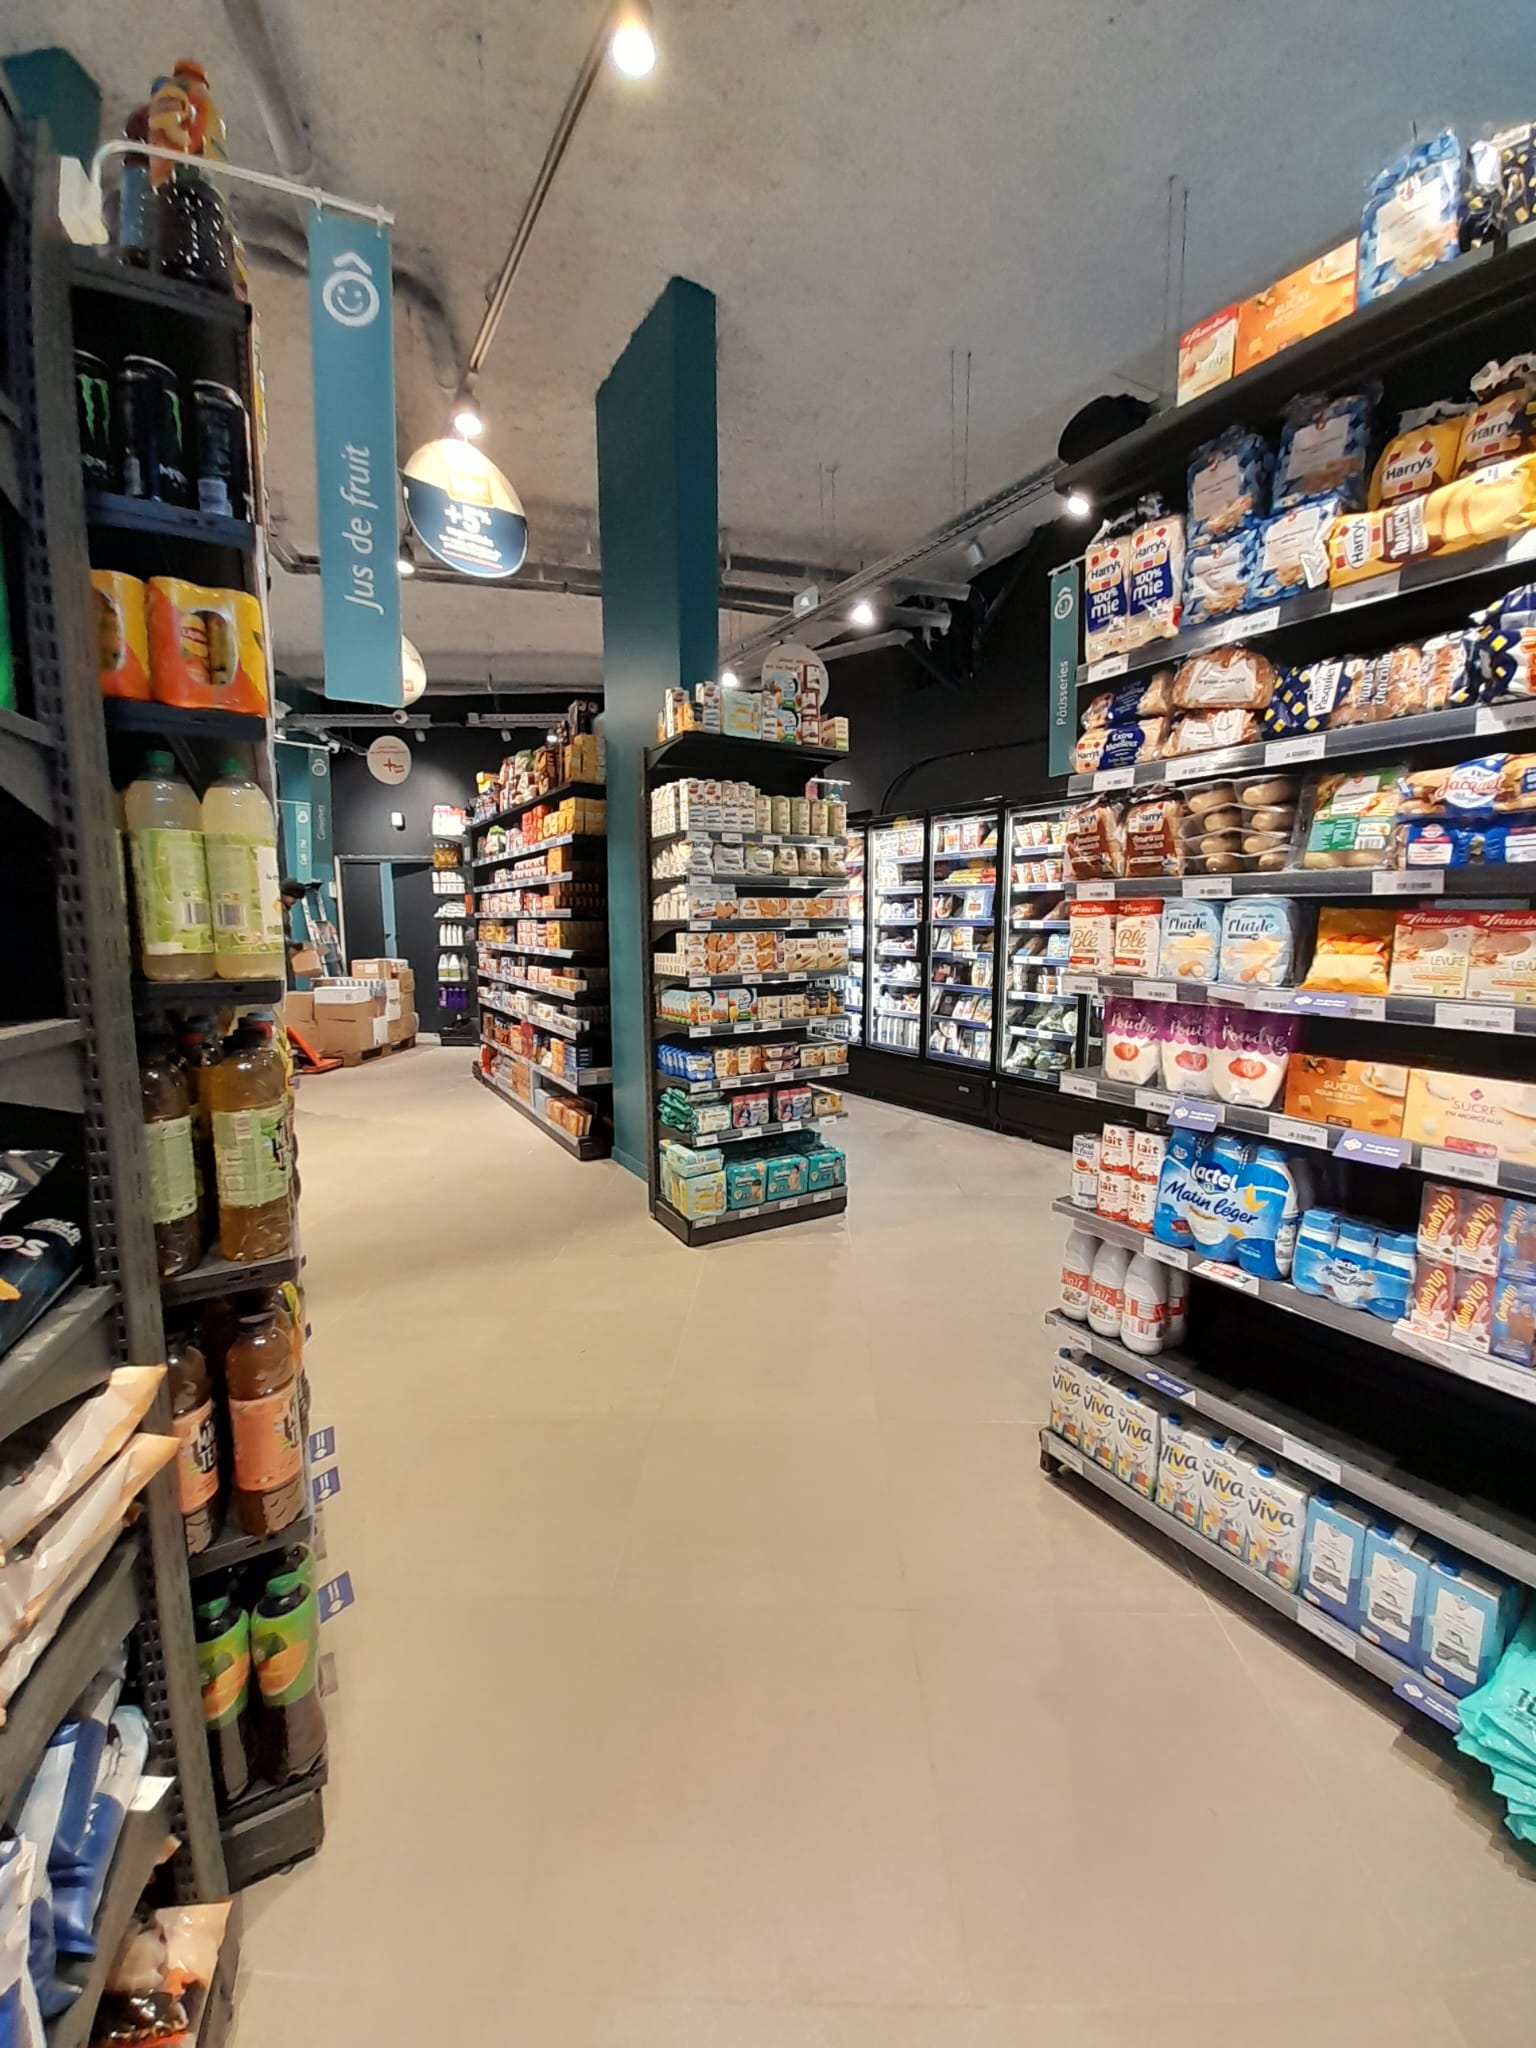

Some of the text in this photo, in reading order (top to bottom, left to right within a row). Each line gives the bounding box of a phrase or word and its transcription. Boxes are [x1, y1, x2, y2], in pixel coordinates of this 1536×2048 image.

[1386, 456, 1433, 481] Harry's
[340, 441, 385, 615] Jus de fruit
[1135, 538, 1167, 559] Harry's
[1091, 560, 1121, 580] Harry's
[1135, 567, 1163, 586] 100%
[1092, 586, 1119, 605] 100%
[1132, 579, 1164, 601] mie
[1091, 598, 1120, 619] mie
[1072, 928, 1098, 949] Blé
[1118, 928, 1146, 949] Blé
[1323, 1079, 1361, 1093] SUCRE
[1452, 1100, 1497, 1115] SUCRE
[1190, 1161, 1239, 1193] lactel
[1164, 1180, 1210, 1212] Matin
[1052, 1373, 1082, 1398] Viva
[1083, 1394, 1116, 1420] Viva
[1117, 1417, 1153, 1444] Viva
[1202, 1468, 1246, 1499] Viva
[1249, 1498, 1296, 1528] Viva
